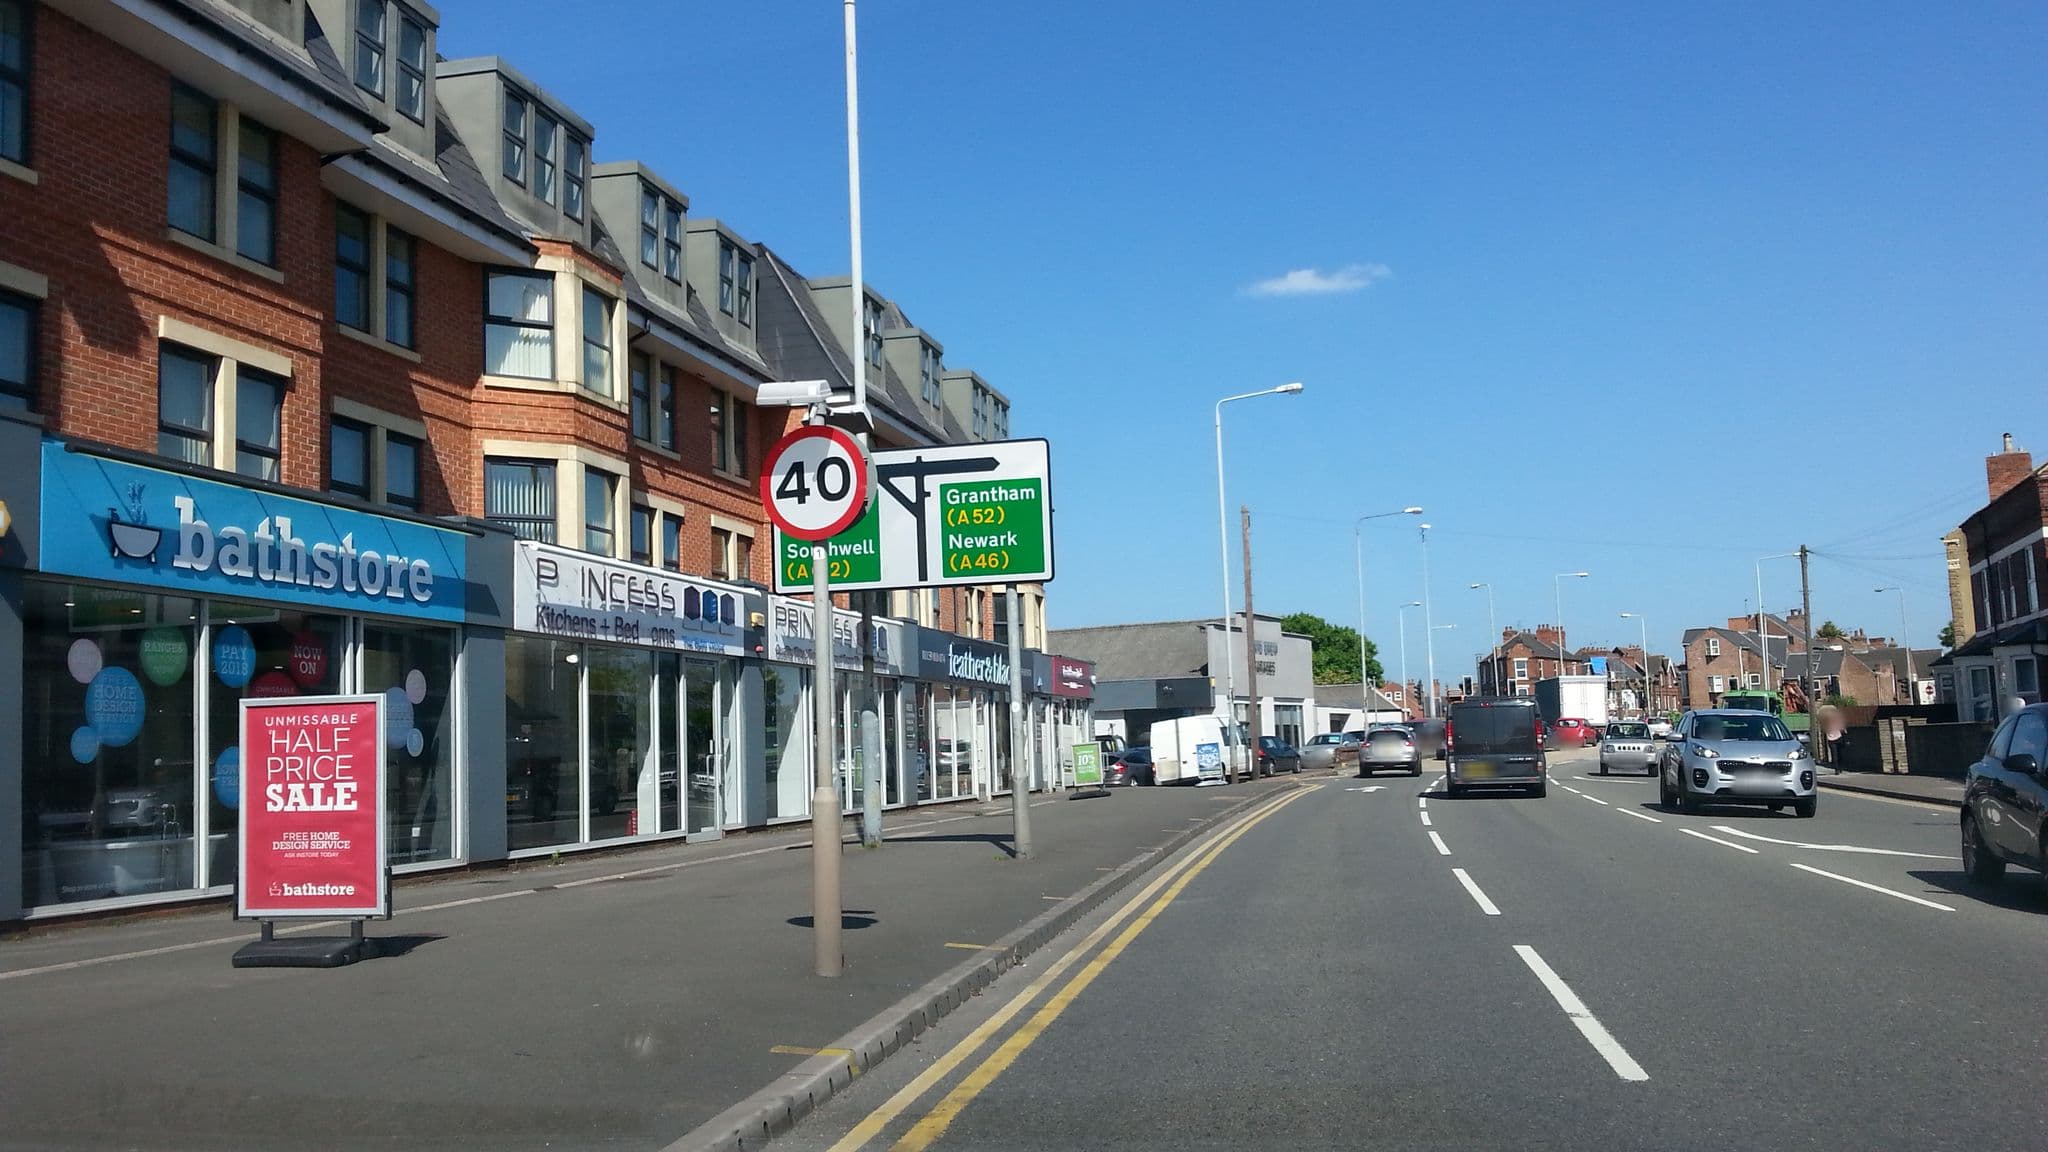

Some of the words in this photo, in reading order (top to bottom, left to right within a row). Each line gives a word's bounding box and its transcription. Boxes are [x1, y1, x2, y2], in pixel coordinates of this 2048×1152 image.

[776, 456, 851, 504] 40
[946, 486, 1036, 505] Grantham
[949, 531, 1018, 550] Newark
[173, 496, 434, 602] bathstore
[787, 539, 875, 559] Sohwell
[787, 560, 850, 580] (A2)
[536, 605, 597, 635] Kitchens
[221, 645, 247, 660] PAY
[294, 646, 322, 660] NOW
[221, 660, 248, 676] 2018
[300, 661, 316, 674] ON
[95, 685, 136, 699] HOME
[95, 700, 136, 712] DESIGN
[265, 713, 358, 726] UNMISSABLE
[267, 755, 354, 781] PRICE
[266, 782, 358, 812] SALE
[283, 832, 309, 841] FREE
[310, 831, 340, 840] HOME
[272, 841, 309, 850] DESIGN
[310, 840, 351, 849] SERVICE
[282, 882, 355, 896] bathstore
